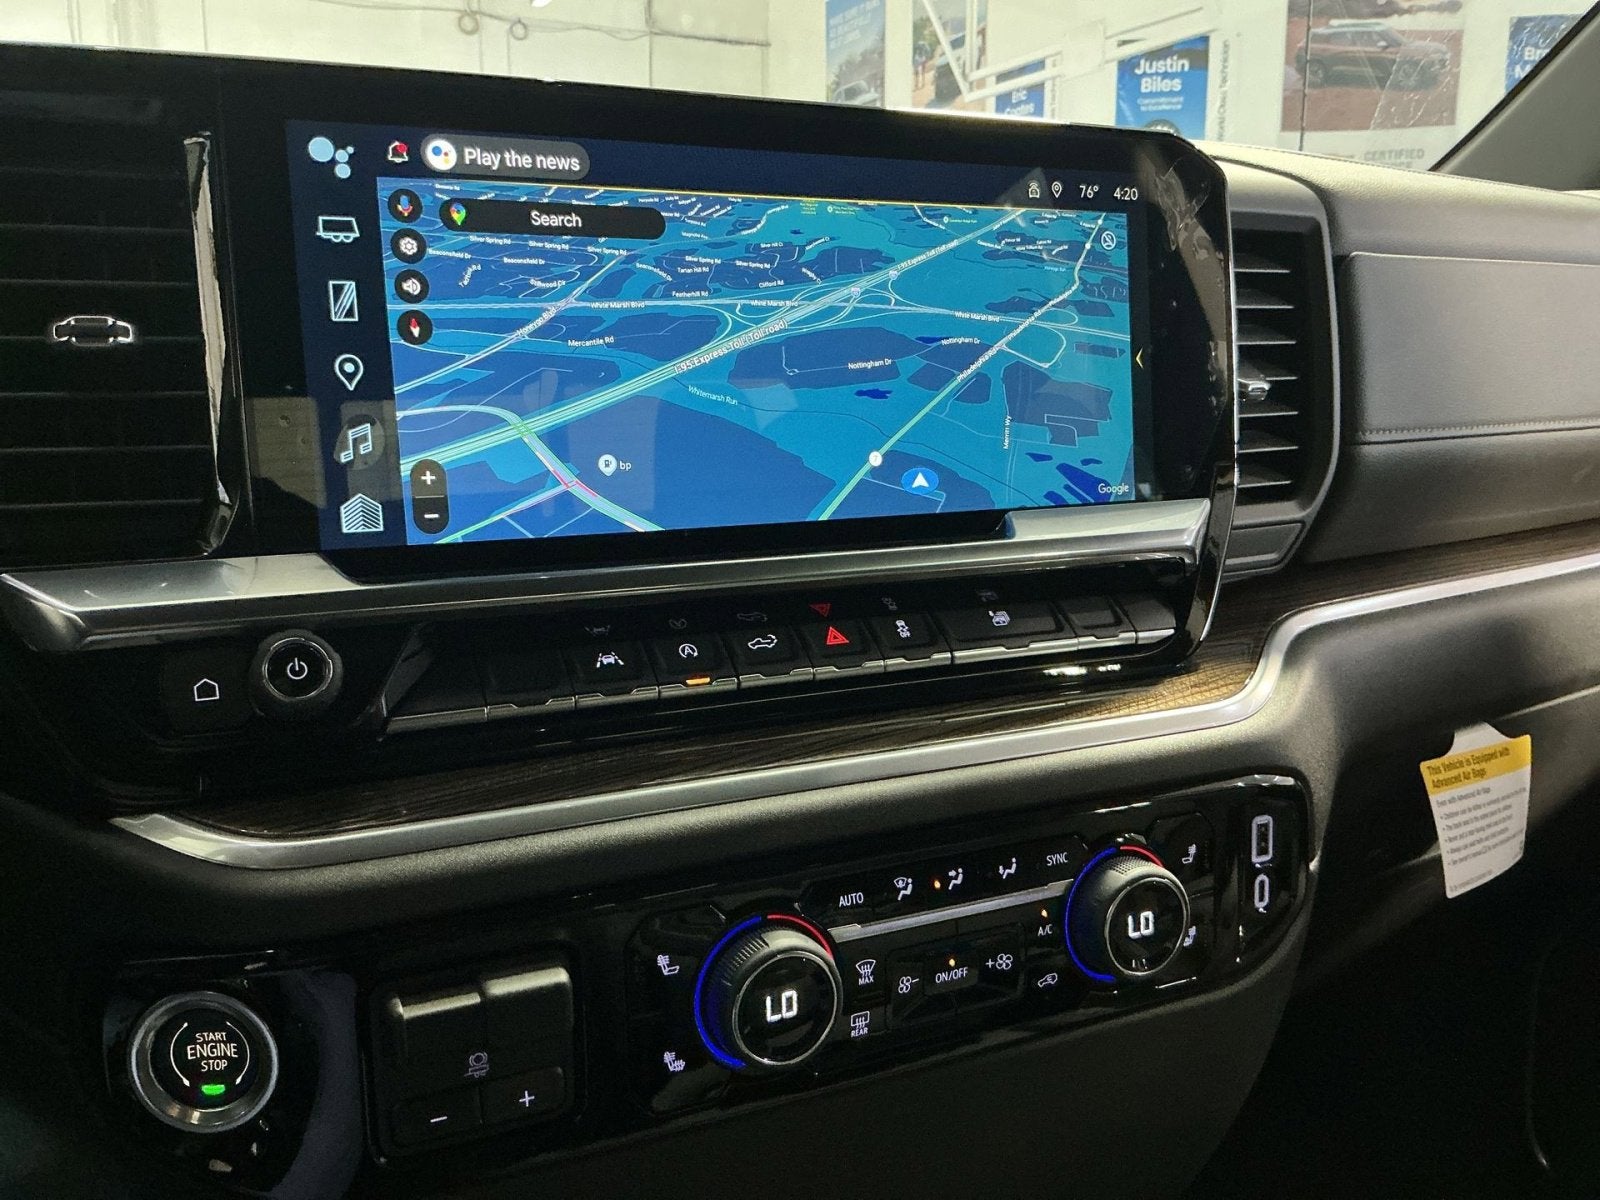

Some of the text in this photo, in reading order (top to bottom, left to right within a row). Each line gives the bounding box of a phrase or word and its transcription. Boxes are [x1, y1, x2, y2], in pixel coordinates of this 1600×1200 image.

[1135, 54, 1189, 74] Justin
[1140, 77, 1182, 92] Biles
[464, 148, 580, 172] Play the news
[1080, 185, 1099, 198] 76°
[1114, 187, 1138, 200] 4:20
[530, 210, 582, 228] Search
[486, 237, 502, 245] Spring
[544, 242, 561, 250] Spring
[428, 248, 464, 258] Beaconsfield
[602, 248, 618, 256] Spring
[700, 256, 714, 264] Spring
[630, 300, 646, 308] Blvd
[517, 306, 558, 336] Honeygo Blvd
[954, 311, 1000, 322] White Marsh Blvd
[568, 336, 614, 348] Mercantile Rd
[694, 346, 728, 367] Express
[729, 336, 746, 351] Toll
[764, 319, 789, 336] road)
[941, 337, 974, 346] Nottingham
[848, 360, 884, 370] Nottingham
[956, 353, 988, 382] Philadelphia
[688, 384, 738, 406] Whitemarsh Run
[619, 460, 632, 472] bp
[1098, 482, 1130, 496] Google
[1426, 764, 1442, 776] This
[1442, 758, 1464, 772] Vehicle
[1471, 750, 1498, 767] Equipped
[1432, 767, 1487, 789] Advanced Air Bags
[1046, 852, 1068, 866] SYNC
[838, 892, 864, 908] AUTO
[1037, 924, 1053, 936] A/C
[1128, 911, 1154, 939] LO
[858, 975, 874, 986] MAX
[935, 966, 969, 984] ON/OFF
[766, 990, 798, 1022] LO
[196, 1032, 227, 1043] START
[850, 1027, 868, 1038] REAR
[187, 1043, 238, 1060] ENGINE
[201, 1060, 228, 1072] STOP
